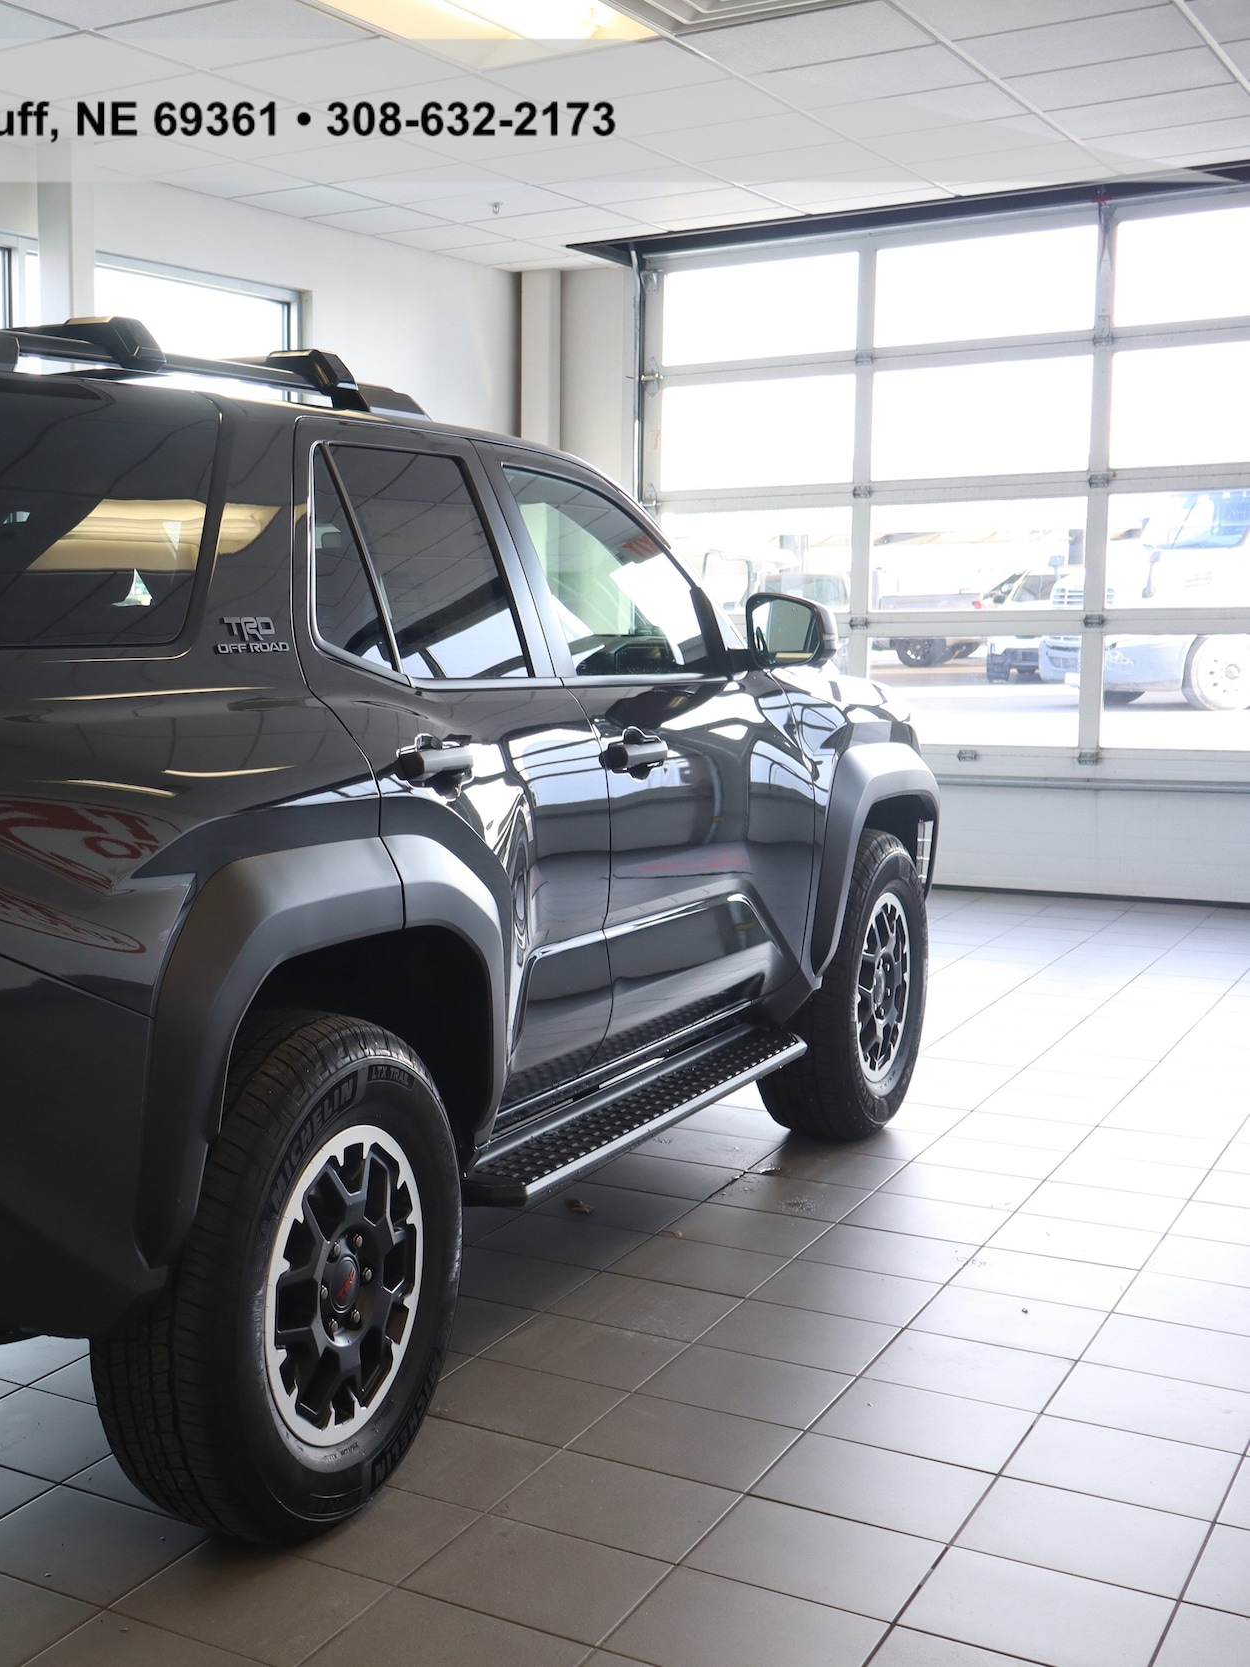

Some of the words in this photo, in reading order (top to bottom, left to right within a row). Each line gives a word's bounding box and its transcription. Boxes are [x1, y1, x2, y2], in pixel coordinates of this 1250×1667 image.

[221, 616, 276, 642] TRD
[215, 642, 248, 655] OFF
[250, 641, 290, 654] ROAD
[371, 1065, 388, 1079] LTX
[270, 1078, 354, 1215] MICHELIN
